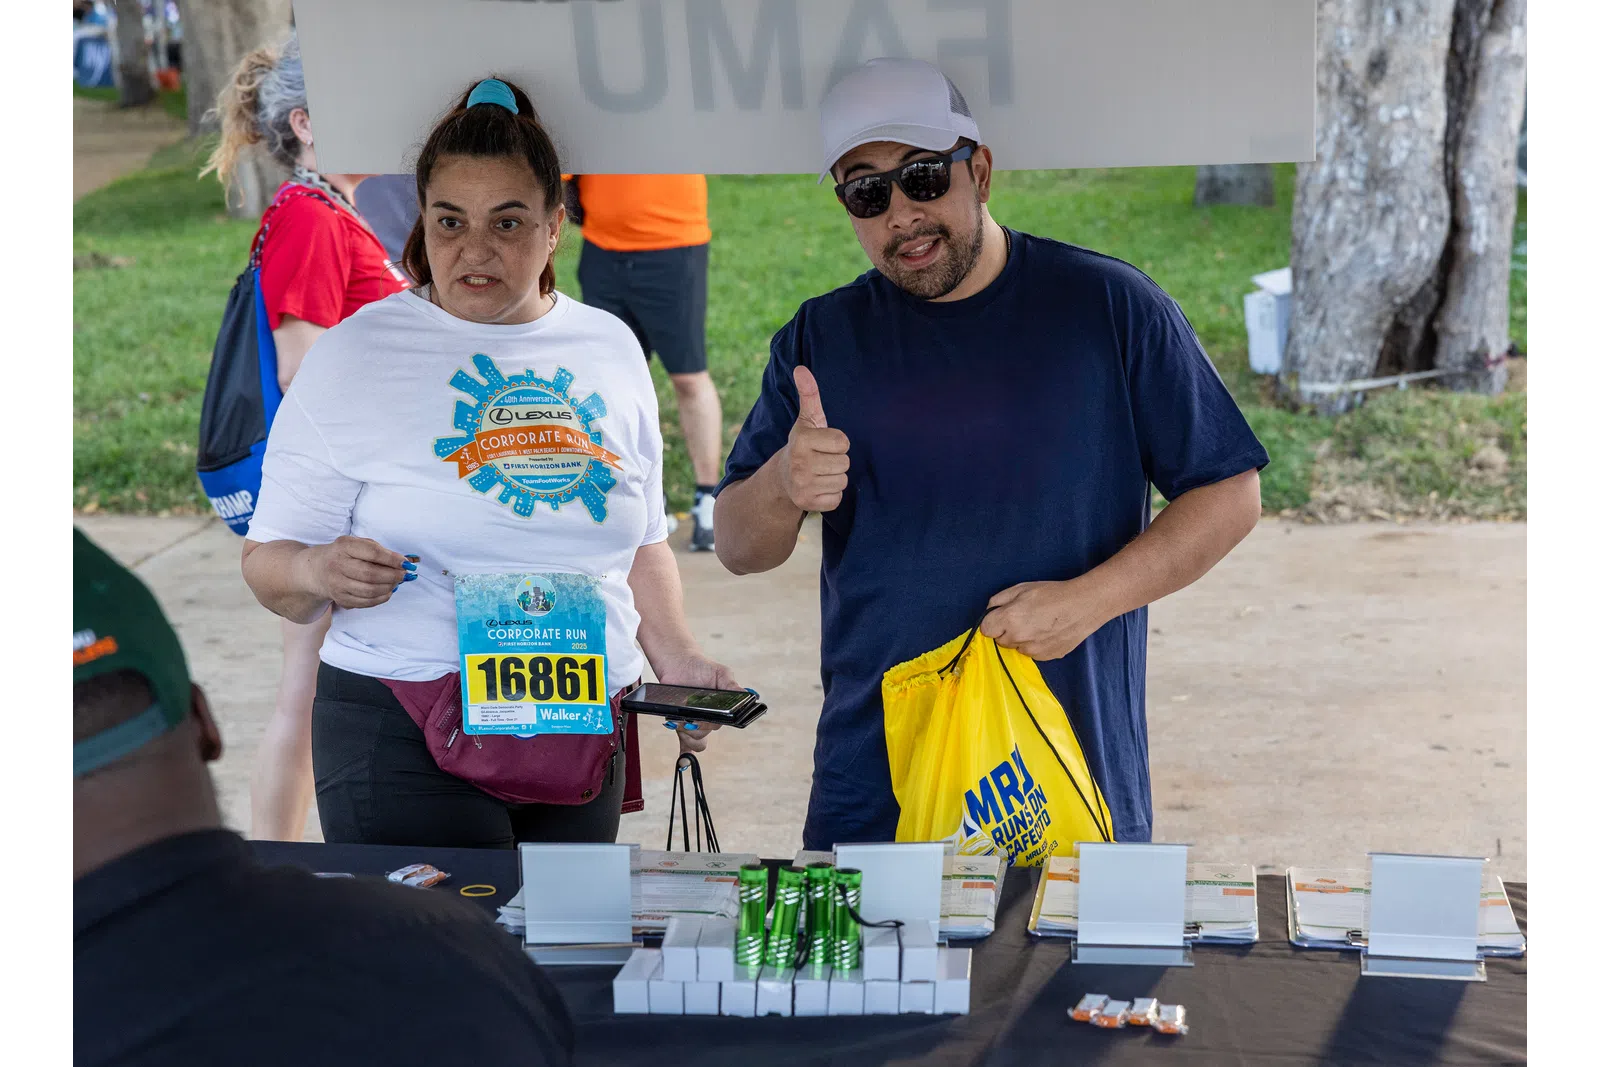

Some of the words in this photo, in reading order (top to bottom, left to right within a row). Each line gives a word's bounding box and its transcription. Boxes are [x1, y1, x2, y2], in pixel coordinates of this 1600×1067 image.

[504, 395, 518, 403] 40th
[520, 395, 554, 404] Anniversary
[515, 410, 572, 420] LEXUS
[480, 430, 561, 451] CORPORATE
[566, 433, 589, 450] RUN
[487, 628, 561, 640] CORPORATE
[566, 628, 587, 640] RUN
[571, 642, 588, 650] 2025
[477, 656, 598, 701] 16861
[540, 708, 581, 721] Walker
[991, 804, 1034, 848] RUNS
[1030, 783, 1048, 817] ON
